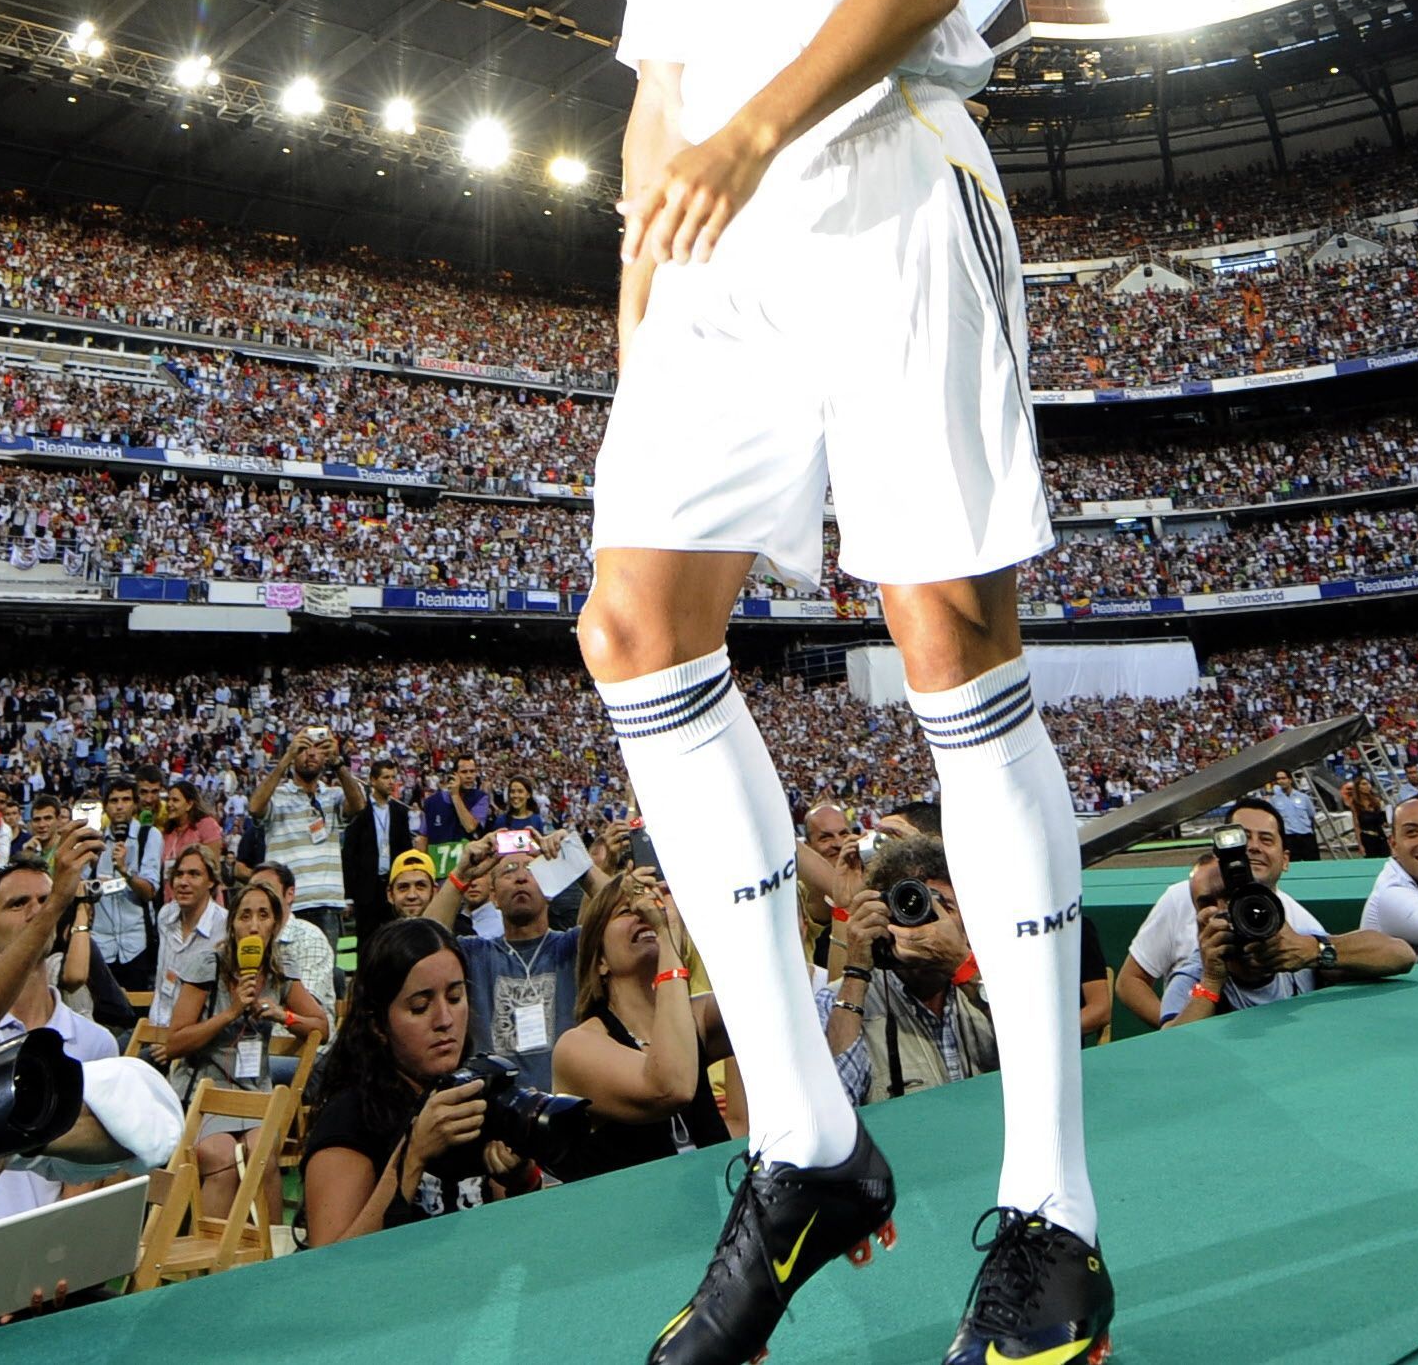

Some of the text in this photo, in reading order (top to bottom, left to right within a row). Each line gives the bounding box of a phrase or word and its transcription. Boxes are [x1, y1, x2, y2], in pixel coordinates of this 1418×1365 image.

[36, 440, 122, 458] Realmadrid
[358, 467, 426, 484] Realmadrid
[417, 591, 489, 608] Realmadrid
[1092, 600, 1151, 614] Realmadrid
[1218, 591, 1284, 606] Realmadrid
[733, 851, 797, 904] RMC
